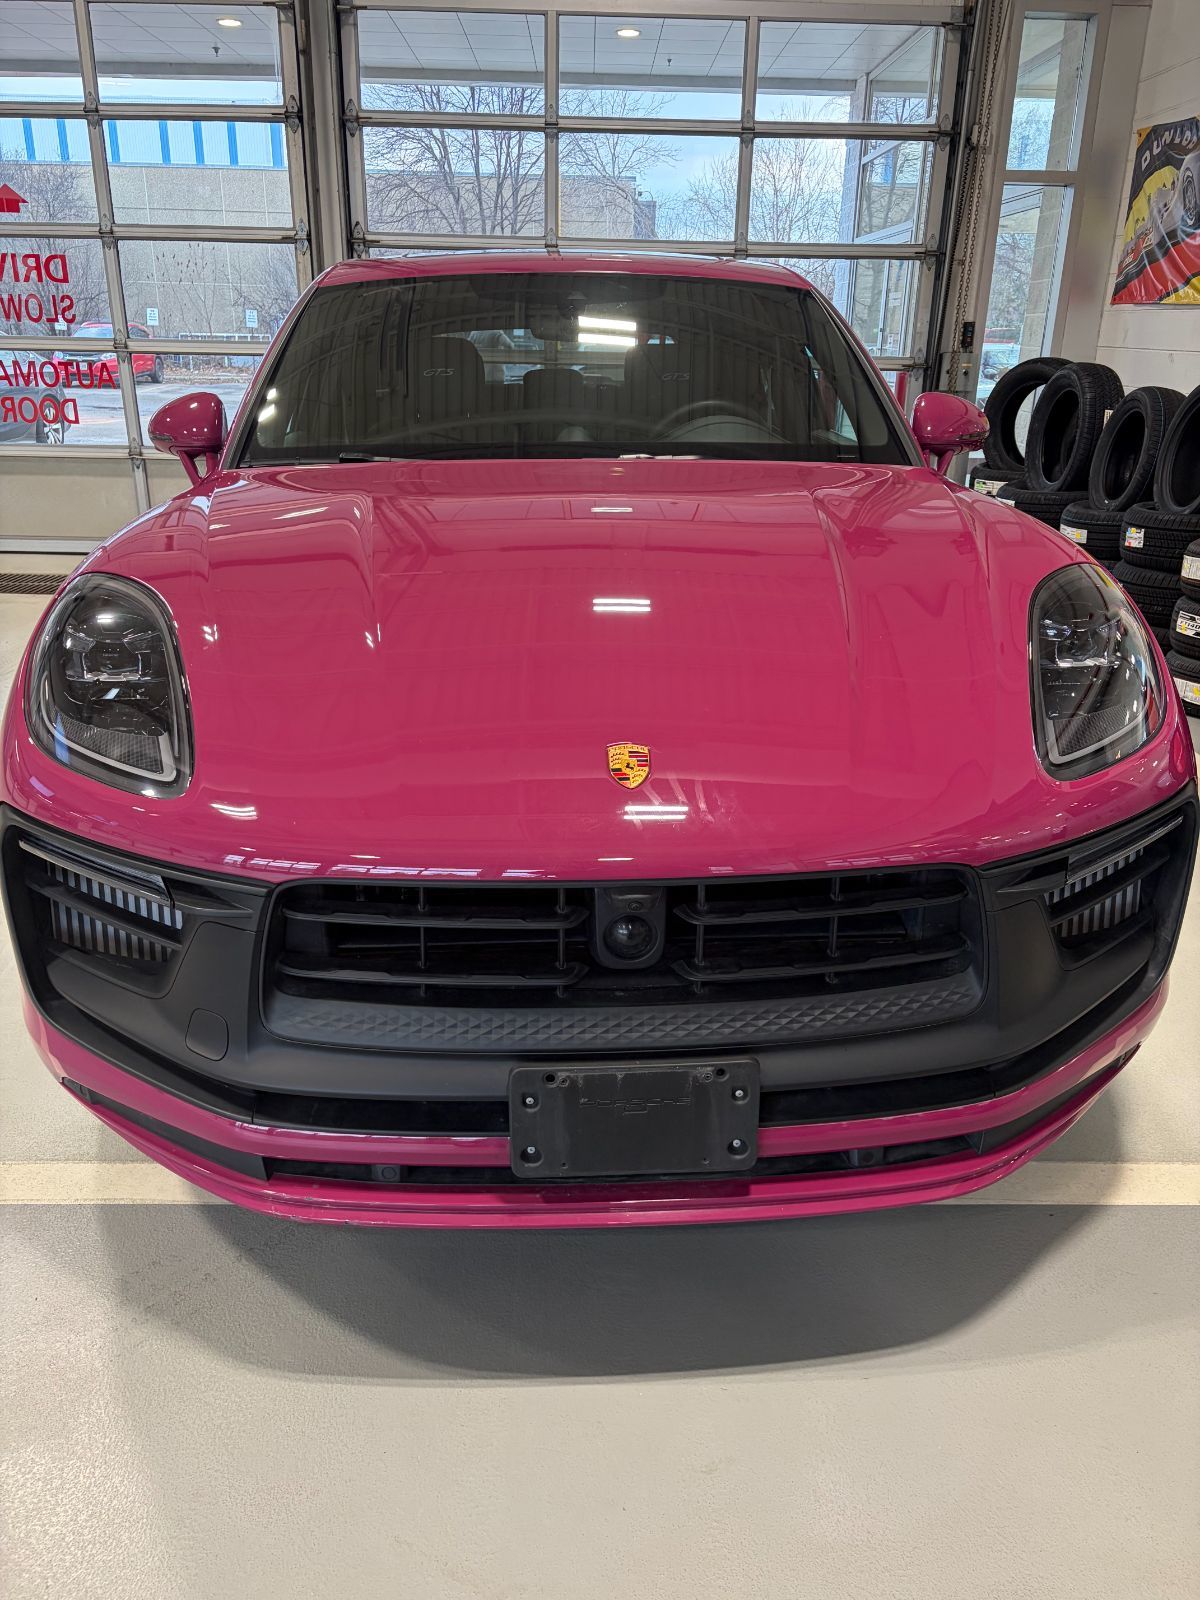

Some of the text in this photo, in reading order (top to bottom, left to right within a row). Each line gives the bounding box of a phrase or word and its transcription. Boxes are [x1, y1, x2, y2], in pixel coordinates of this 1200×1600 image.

[1141, 128, 1198, 171] DUNLOP
[423, 366, 455, 377] GTS
[661, 372, 691, 381] GTS
